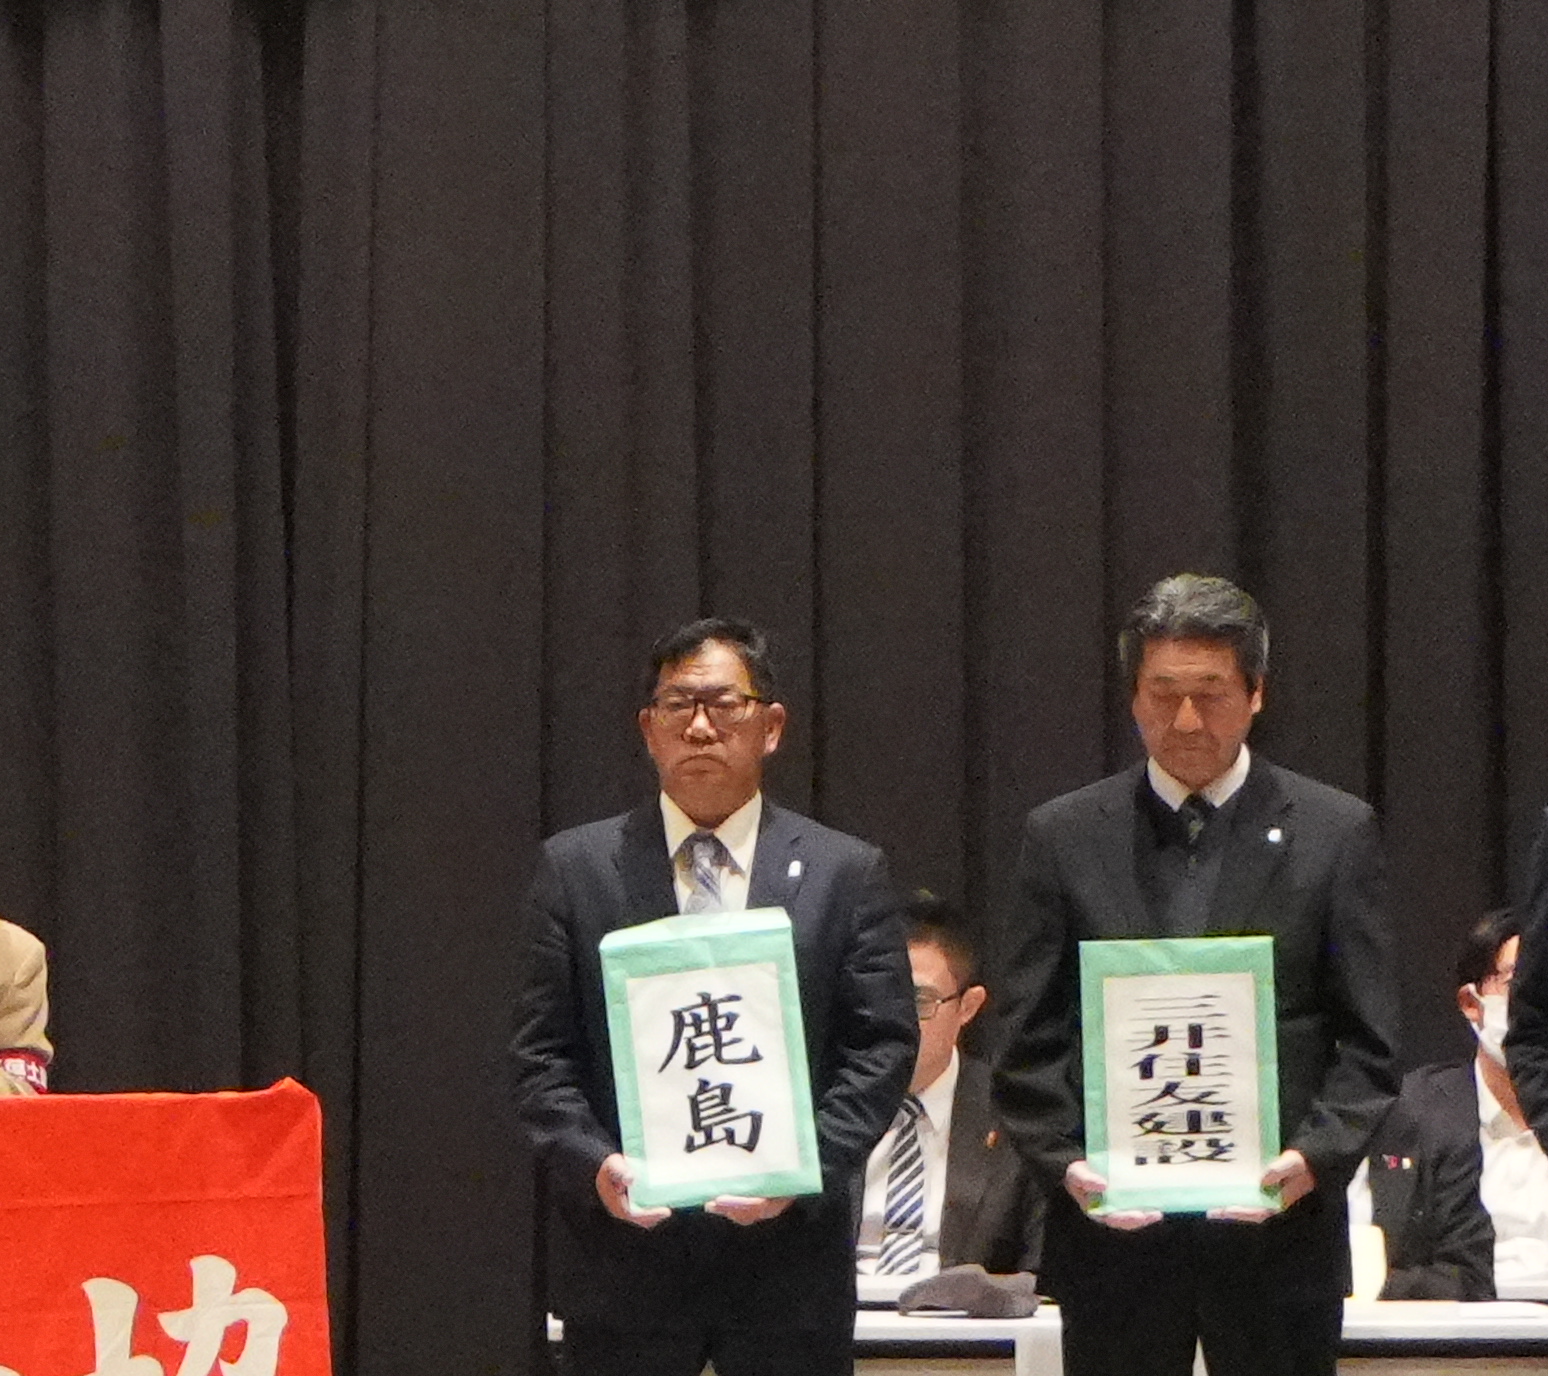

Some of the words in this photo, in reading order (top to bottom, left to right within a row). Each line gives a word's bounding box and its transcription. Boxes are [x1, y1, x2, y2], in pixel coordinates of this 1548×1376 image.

[659, 991, 764, 1154] 鹿島
[1126, 994, 1237, 1165] 三井住友建設
